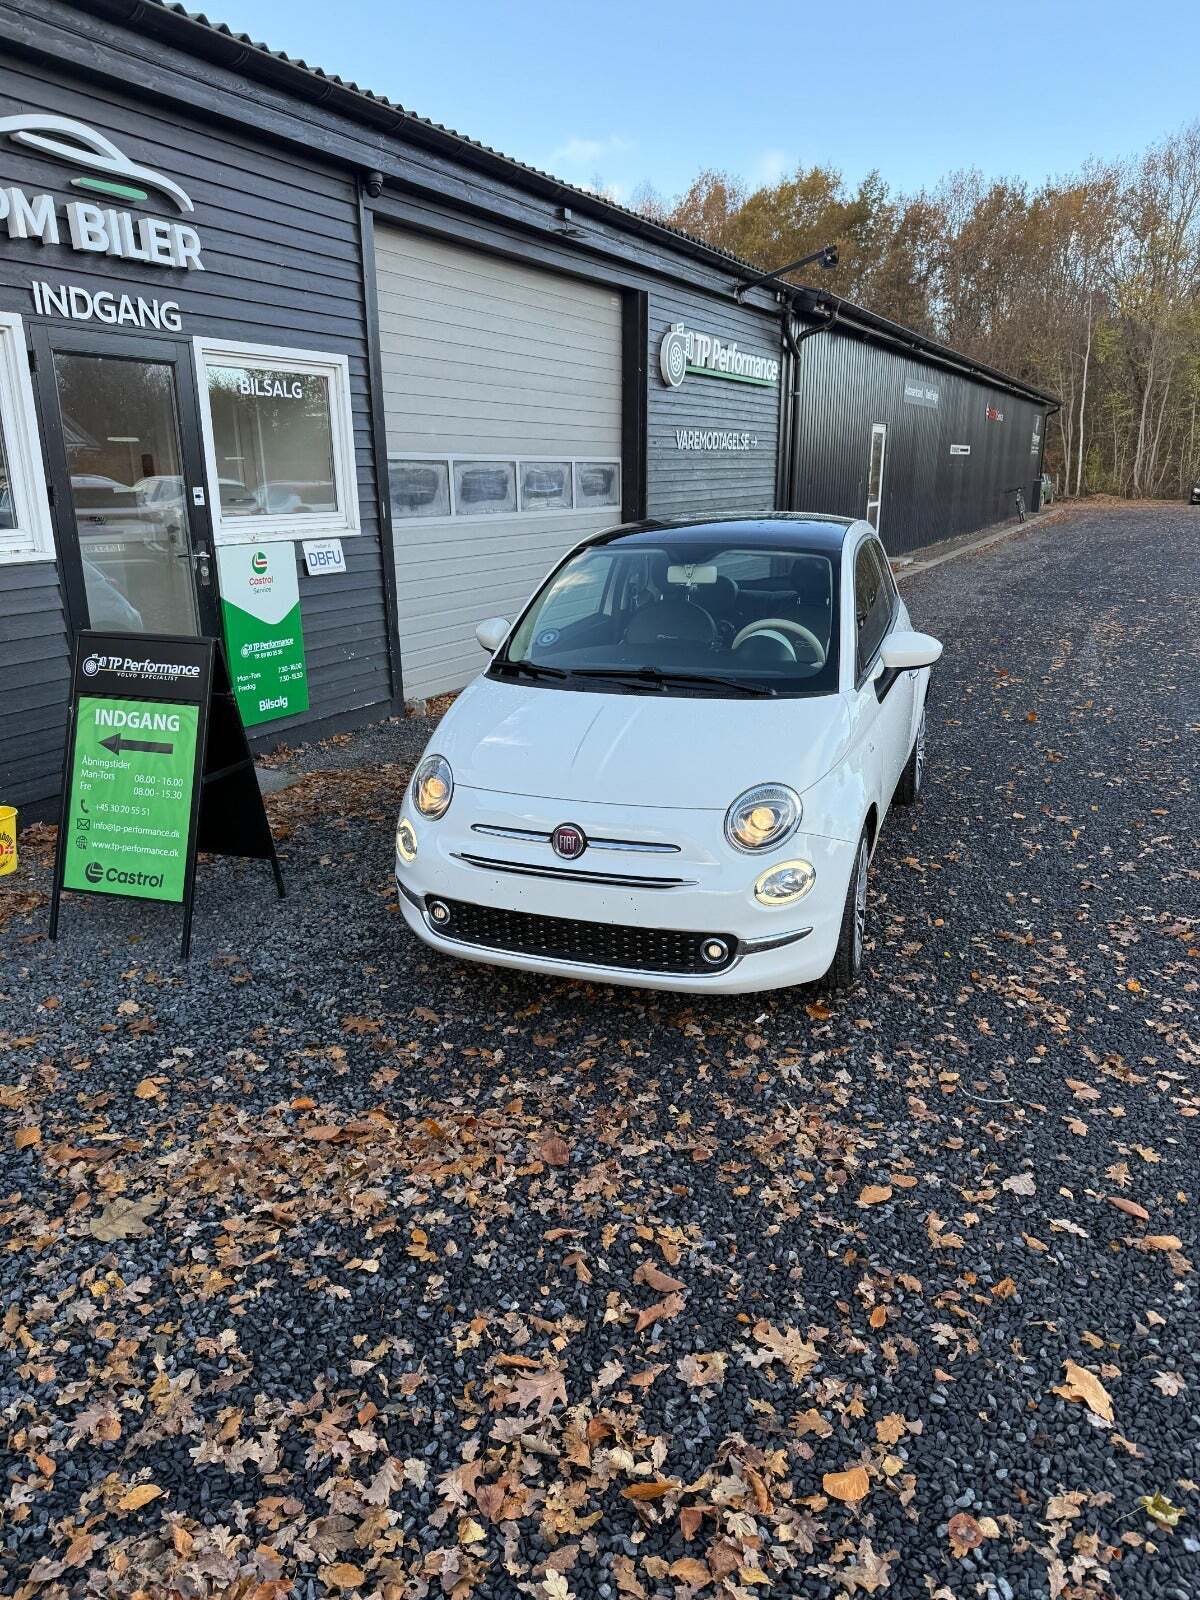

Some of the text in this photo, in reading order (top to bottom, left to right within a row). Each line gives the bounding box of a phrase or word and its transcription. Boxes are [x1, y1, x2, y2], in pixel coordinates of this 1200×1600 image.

[66, 201, 205, 271] BILER
[32, 280, 182, 331] INDGANG
[693, 334, 778, 381] TP Performance
[240, 377, 303, 399] BILSALG
[676, 430, 750, 450] VAREMODTAGELSE
[308, 550, 341, 567] DBFU
[249, 576, 274, 586] Castrol
[260, 638, 294, 650] Performance
[108, 656, 200, 676] TP Performance
[141, 673, 178, 682] SPECIALIST
[259, 696, 288, 711] Bilsalg
[95, 708, 180, 731] INDGANG
[80, 769, 115, 780] Man-Tors
[134, 774, 156, 784] 08.00
[162, 777, 184, 786] 16.00
[80, 781, 92, 790] Fre
[133, 787, 155, 796] 08.00
[162, 790, 182, 800] 15.30
[109, 804, 119, 812] 30
[93, 821, 180, 838] info@tp-performance.dk
[91, 840, 179, 857] www.tp-performance.dk
[559, 835, 577, 850] FIAT
[106, 868, 164, 888] Castrol
